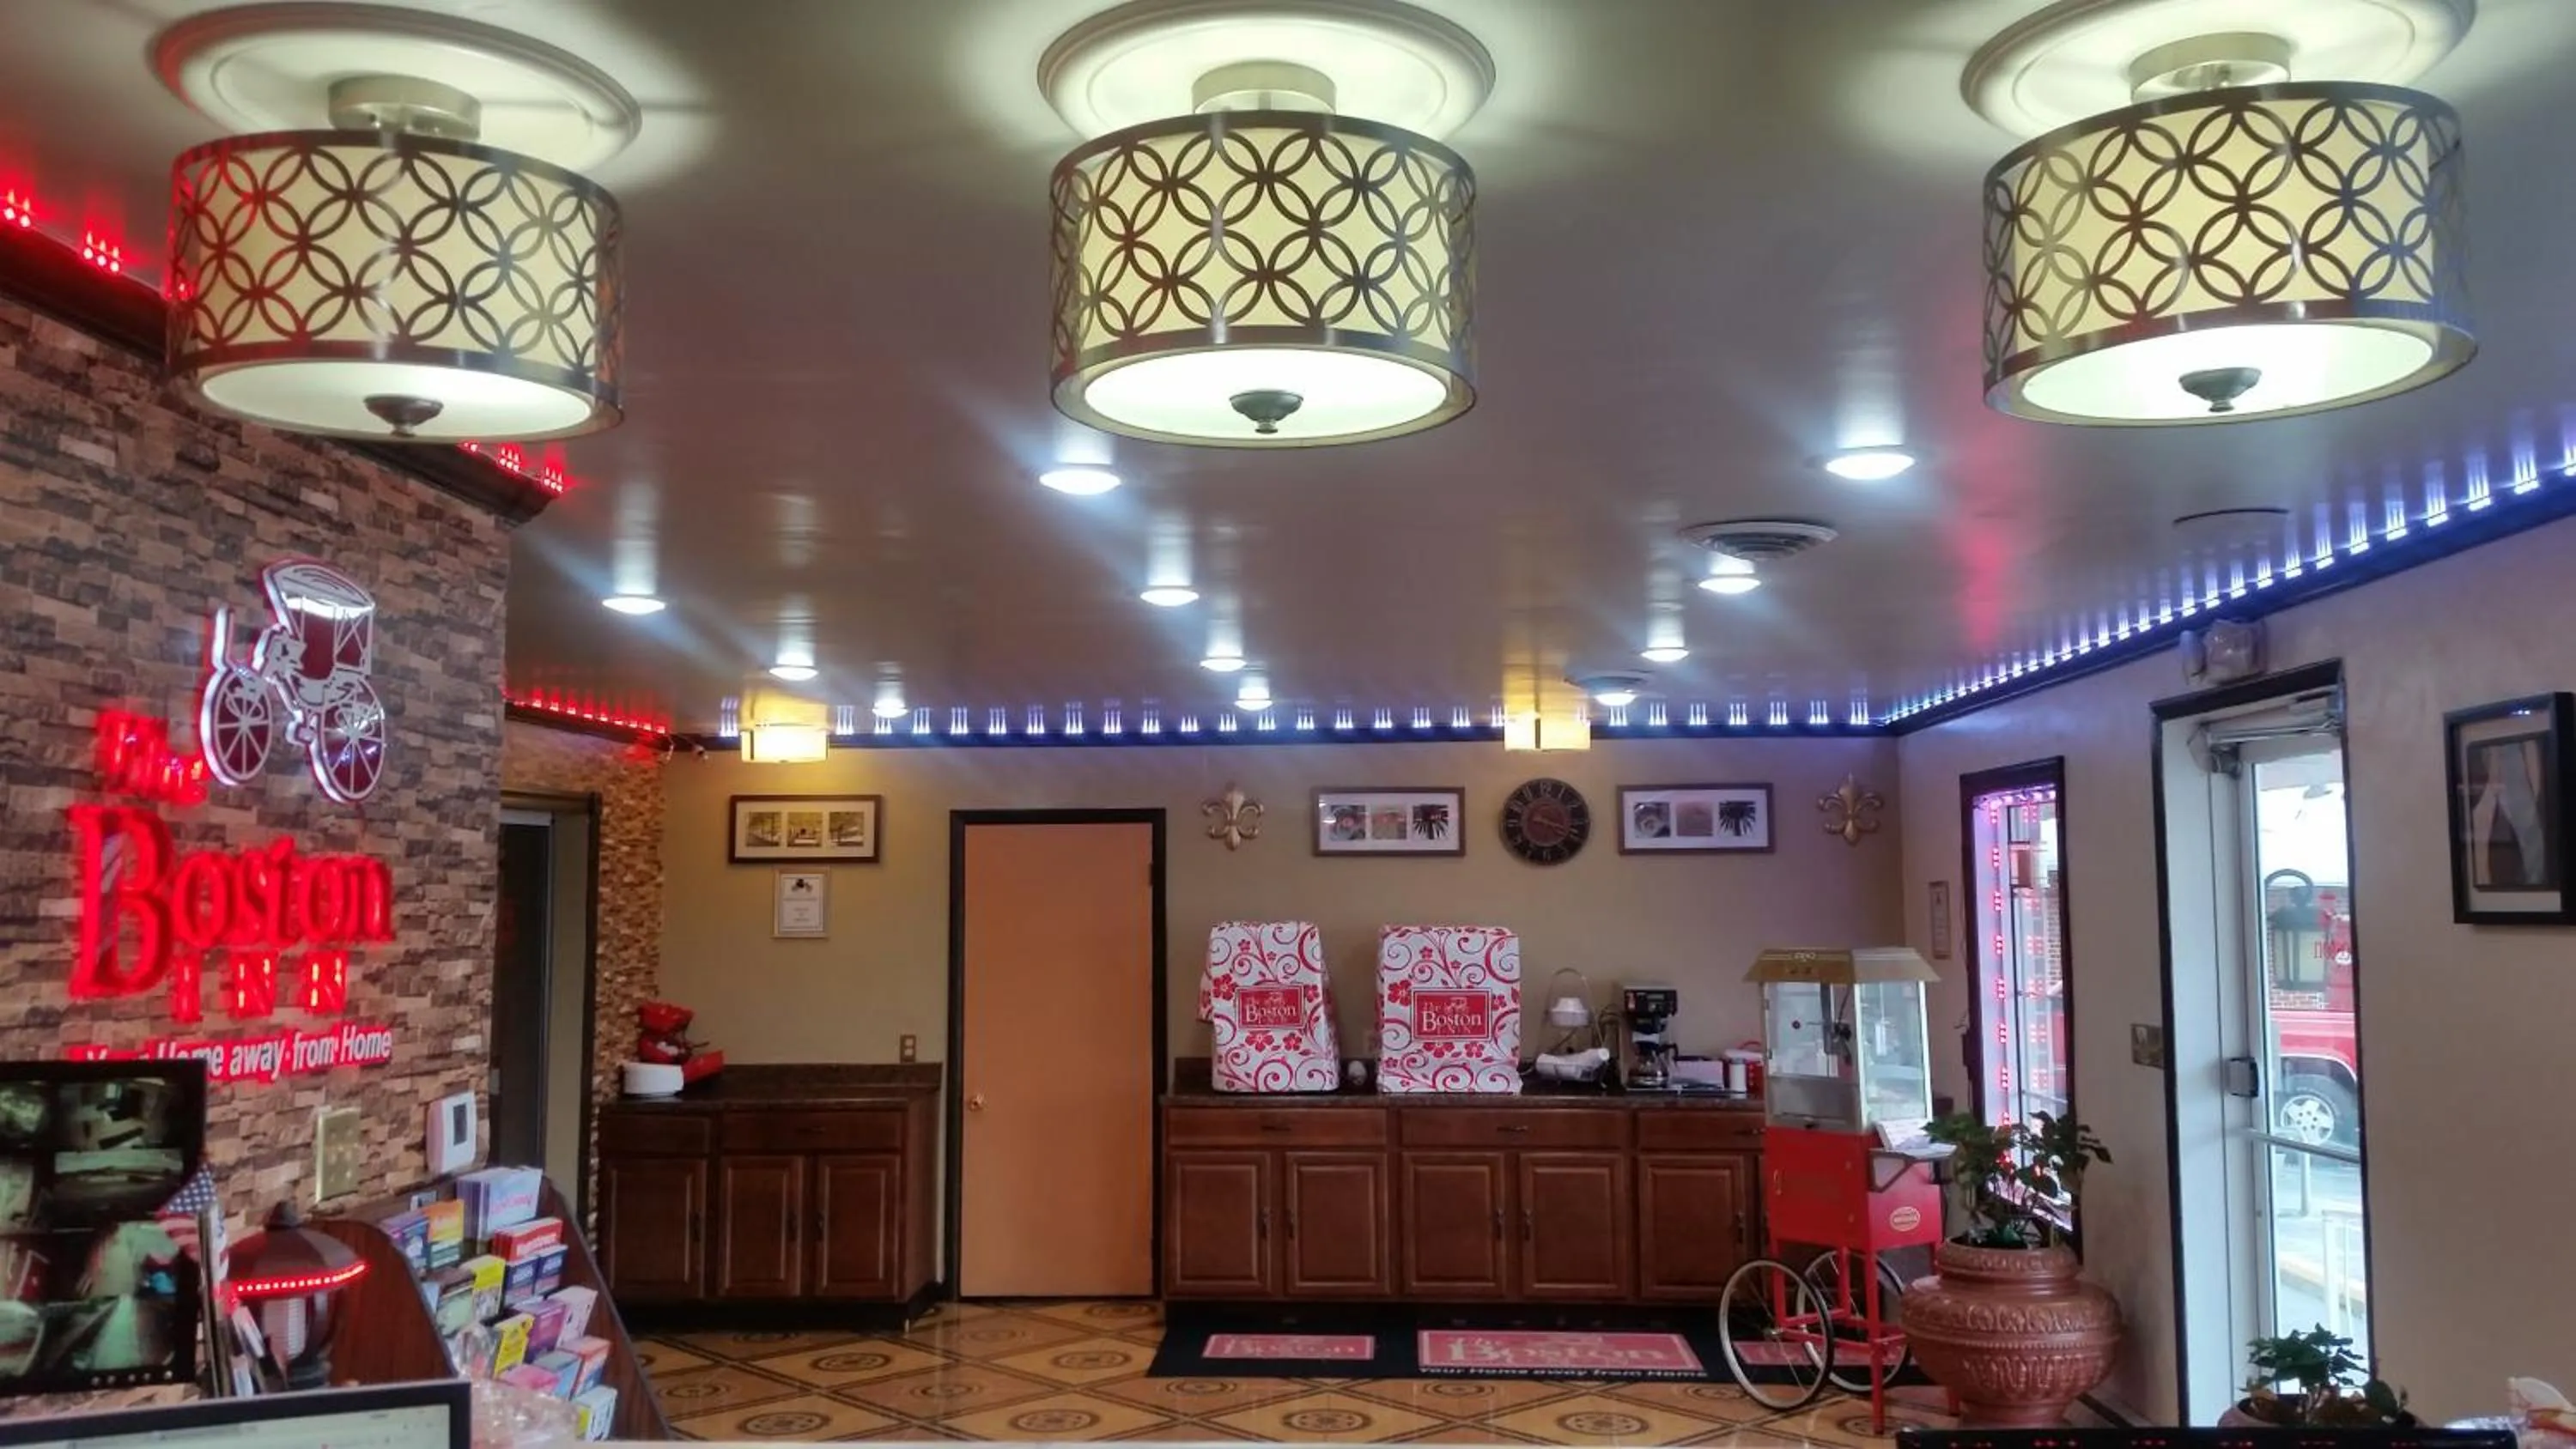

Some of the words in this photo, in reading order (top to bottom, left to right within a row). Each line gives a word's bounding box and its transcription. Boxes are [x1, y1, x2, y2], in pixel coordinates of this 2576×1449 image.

[69, 805, 393, 998] Boston
[170, 949, 348, 1022] INN
[1246, 1004, 1297, 1023] Boston
[1422, 1010, 1482, 1032] Boston
[229, 1040, 283, 1079] away
[292, 1033, 336, 1072] from
[343, 1026, 392, 1061] Home
